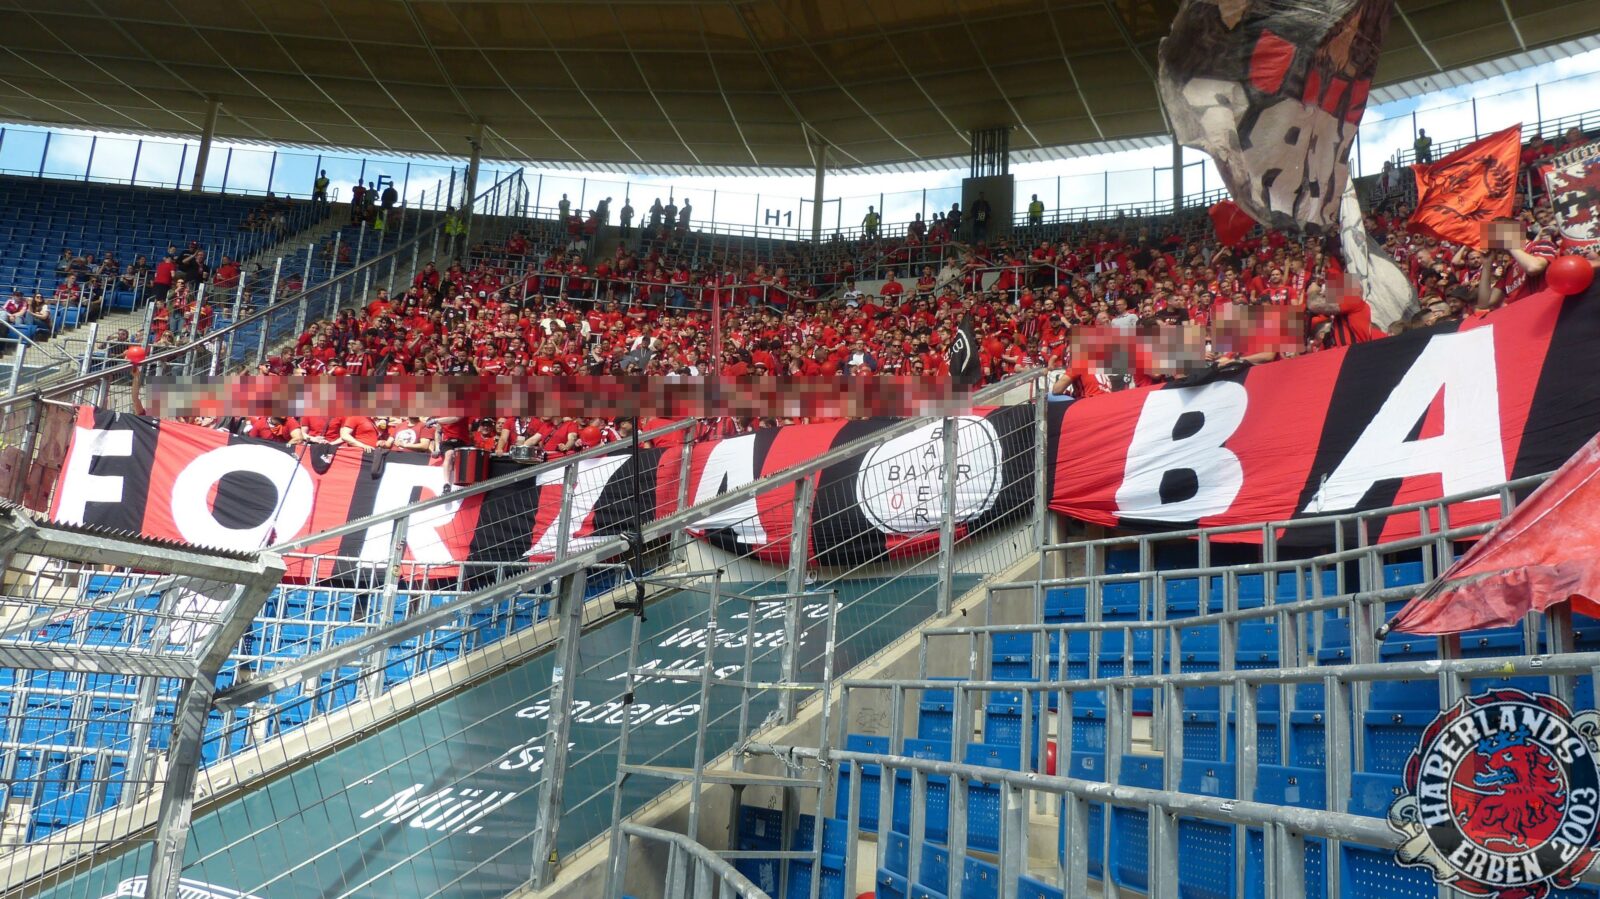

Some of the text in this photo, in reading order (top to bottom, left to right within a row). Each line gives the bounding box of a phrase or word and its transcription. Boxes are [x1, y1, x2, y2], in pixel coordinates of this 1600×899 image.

[376, 174, 392, 192] F
[764, 208, 792, 227] H1
[1112, 324, 1507, 521] BA
[54, 426, 768, 568] FORZA
[515, 696, 701, 726] andere
